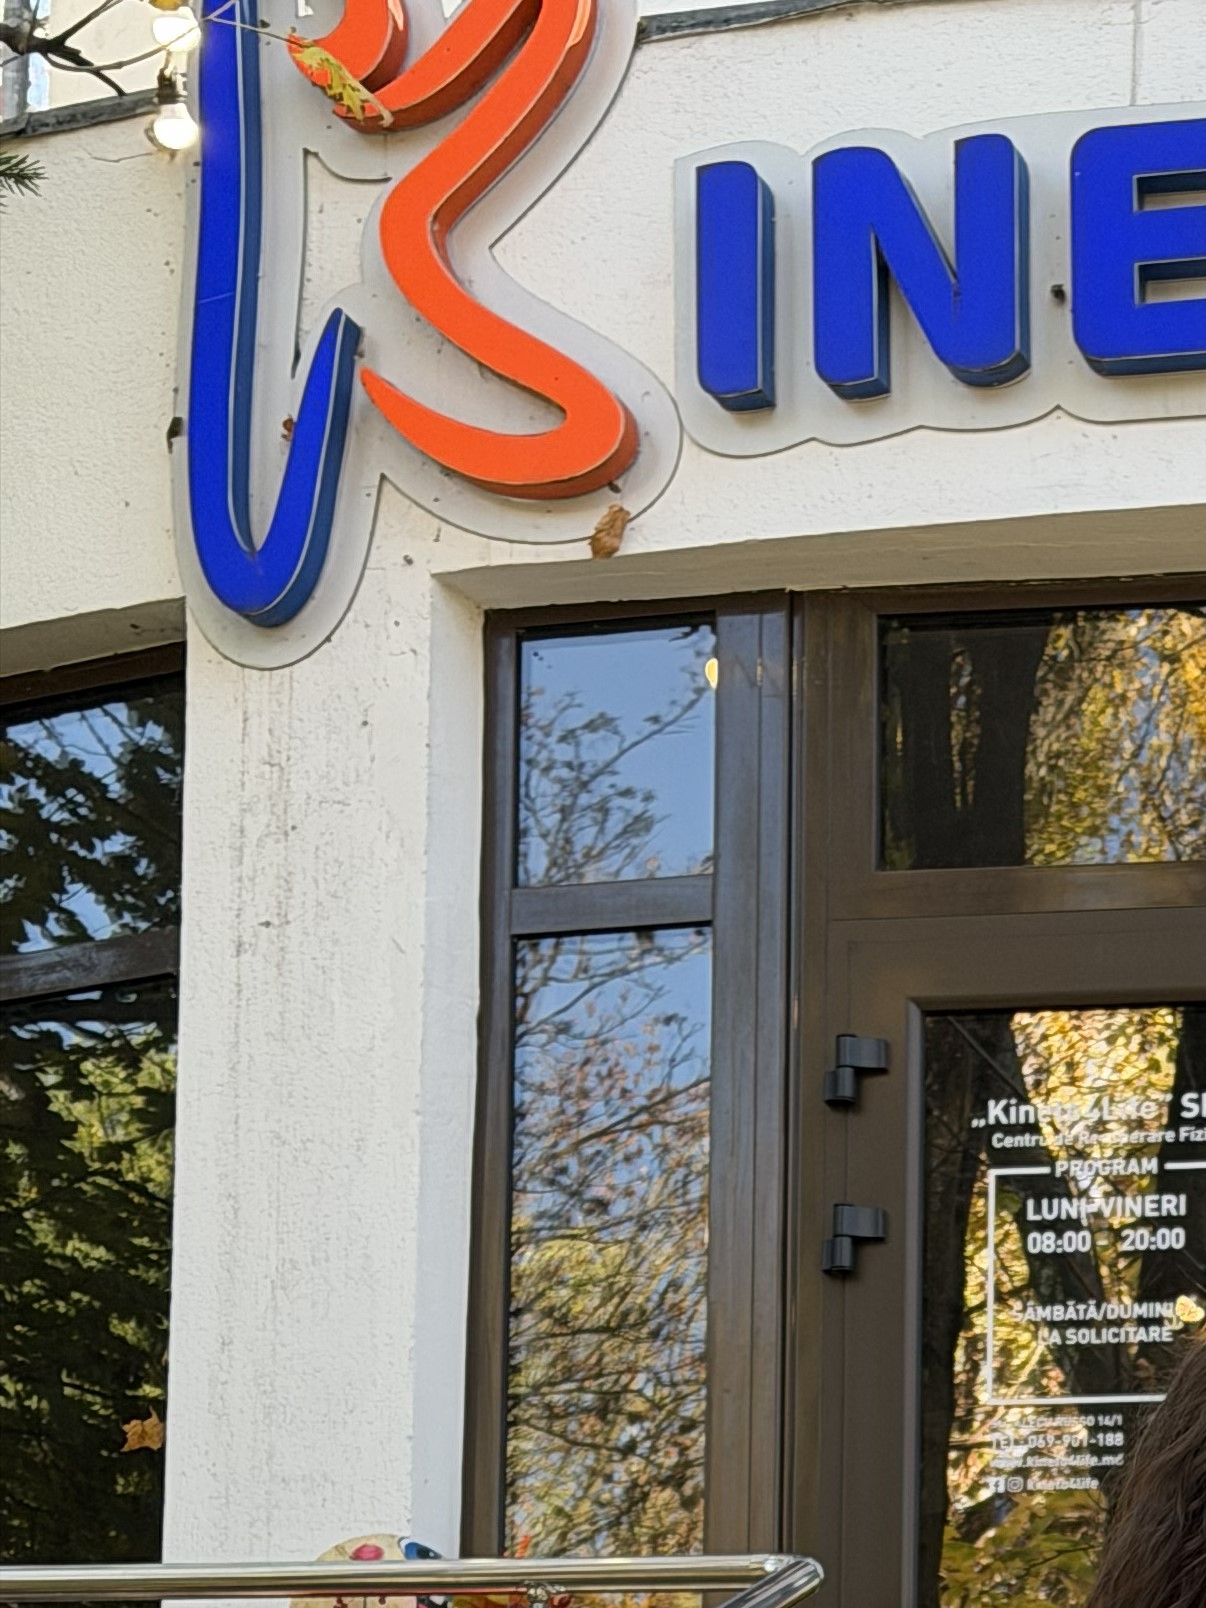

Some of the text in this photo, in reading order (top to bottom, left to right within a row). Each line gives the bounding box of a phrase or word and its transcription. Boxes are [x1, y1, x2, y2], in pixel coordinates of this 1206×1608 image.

[1055, 1156, 1158, 1178] PROGRAM
[1027, 1230, 1092, 1253] 08:00
[1120, 1227, 1186, 1251] 20:00
[1065, 1325, 1174, 1344] SOLICITARE
[1097, 1413, 1123, 1427] 14/1
[1028, 1431, 1124, 1449] 069-901-188
